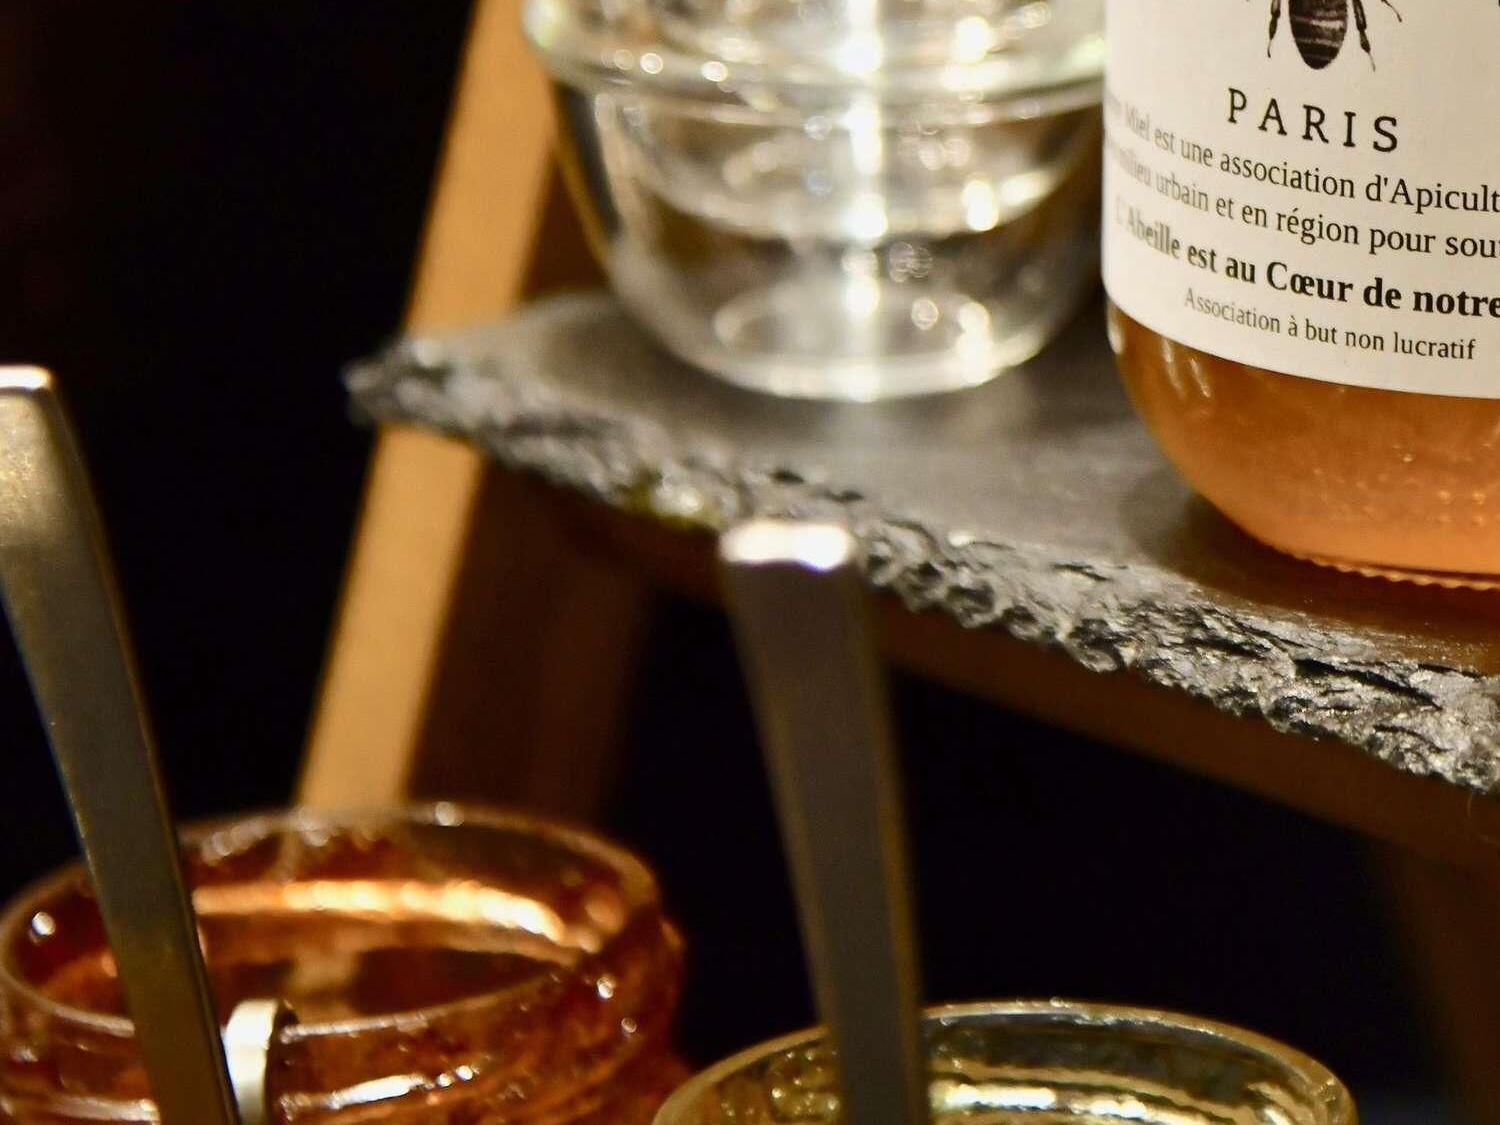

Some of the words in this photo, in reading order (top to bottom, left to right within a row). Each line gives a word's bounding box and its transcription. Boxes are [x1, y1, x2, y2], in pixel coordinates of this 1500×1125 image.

[1228, 88, 1398, 152] PARIS
[1154, 127, 1175, 154] est
[1181, 137, 1213, 167] une
[1220, 152, 1355, 199] association
[1156, 172, 1209, 213] urbain
[1216, 196, 1234, 220] et
[1242, 205, 1267, 228] en
[1277, 208, 1358, 246] région
[1368, 227, 1436, 255] pour
[1188, 240, 1217, 274] est
[1226, 256, 1256, 284] au
[1266, 260, 1353, 303] Cœur
[1363, 277, 1401, 309] de
[1184, 287, 1280, 334] Association
[1287, 315, 1298, 337] à
[1305, 318, 1338, 345] but
[1344, 329, 1385, 352] non
[1393, 331, 1476, 361] lucratif
